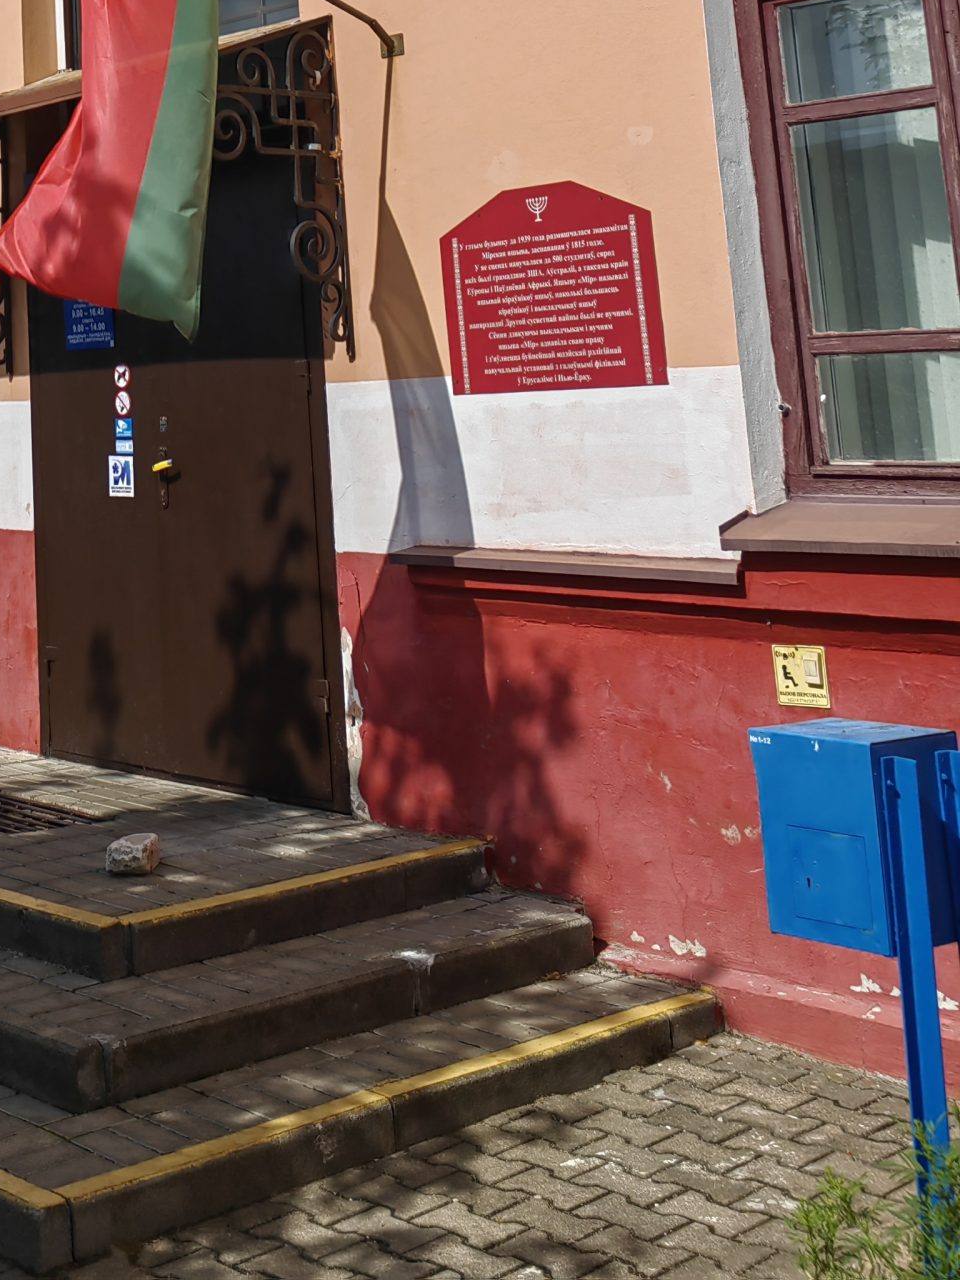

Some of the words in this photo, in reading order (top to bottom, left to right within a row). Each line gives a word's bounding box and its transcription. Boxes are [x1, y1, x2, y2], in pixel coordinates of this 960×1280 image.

[518, 235, 531, 243] 1939
[571, 240, 586, 249] 1815
[552, 255, 563, 263] 500
